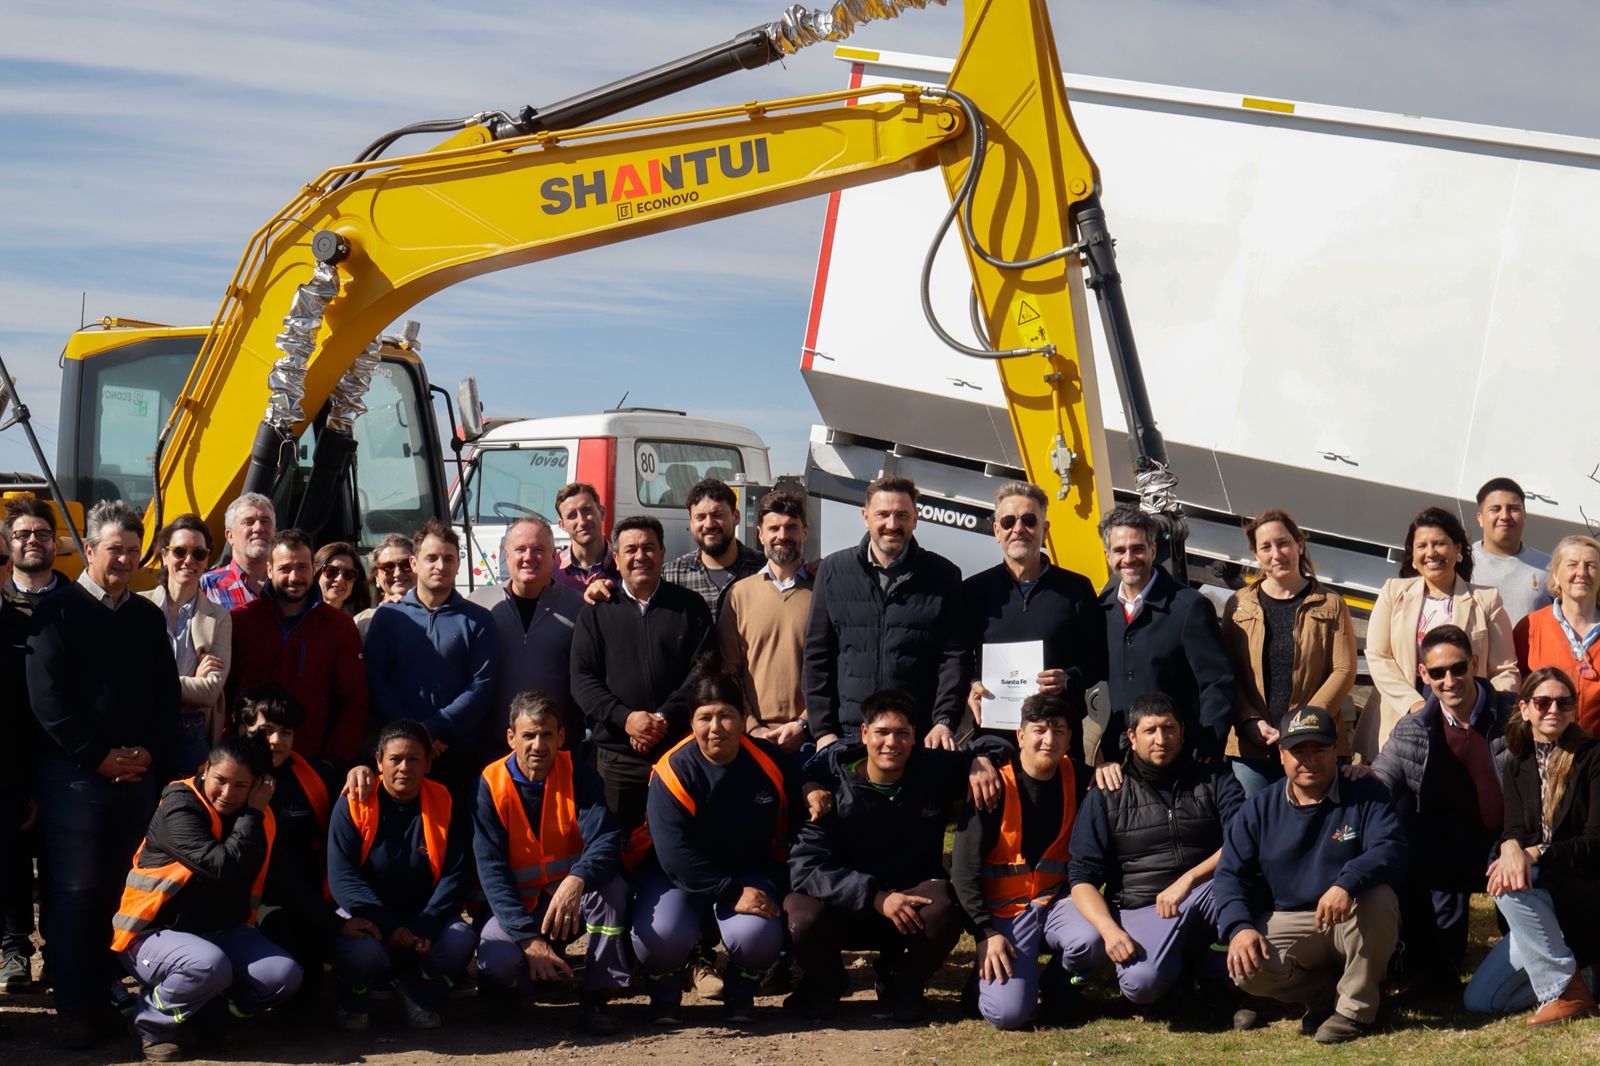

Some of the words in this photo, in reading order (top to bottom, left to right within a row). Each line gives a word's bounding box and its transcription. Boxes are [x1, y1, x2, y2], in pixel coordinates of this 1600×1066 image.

[540, 137, 770, 216] SHANTUI
[637, 191, 700, 214] ECONOVO
[640, 452, 655, 473] 80
